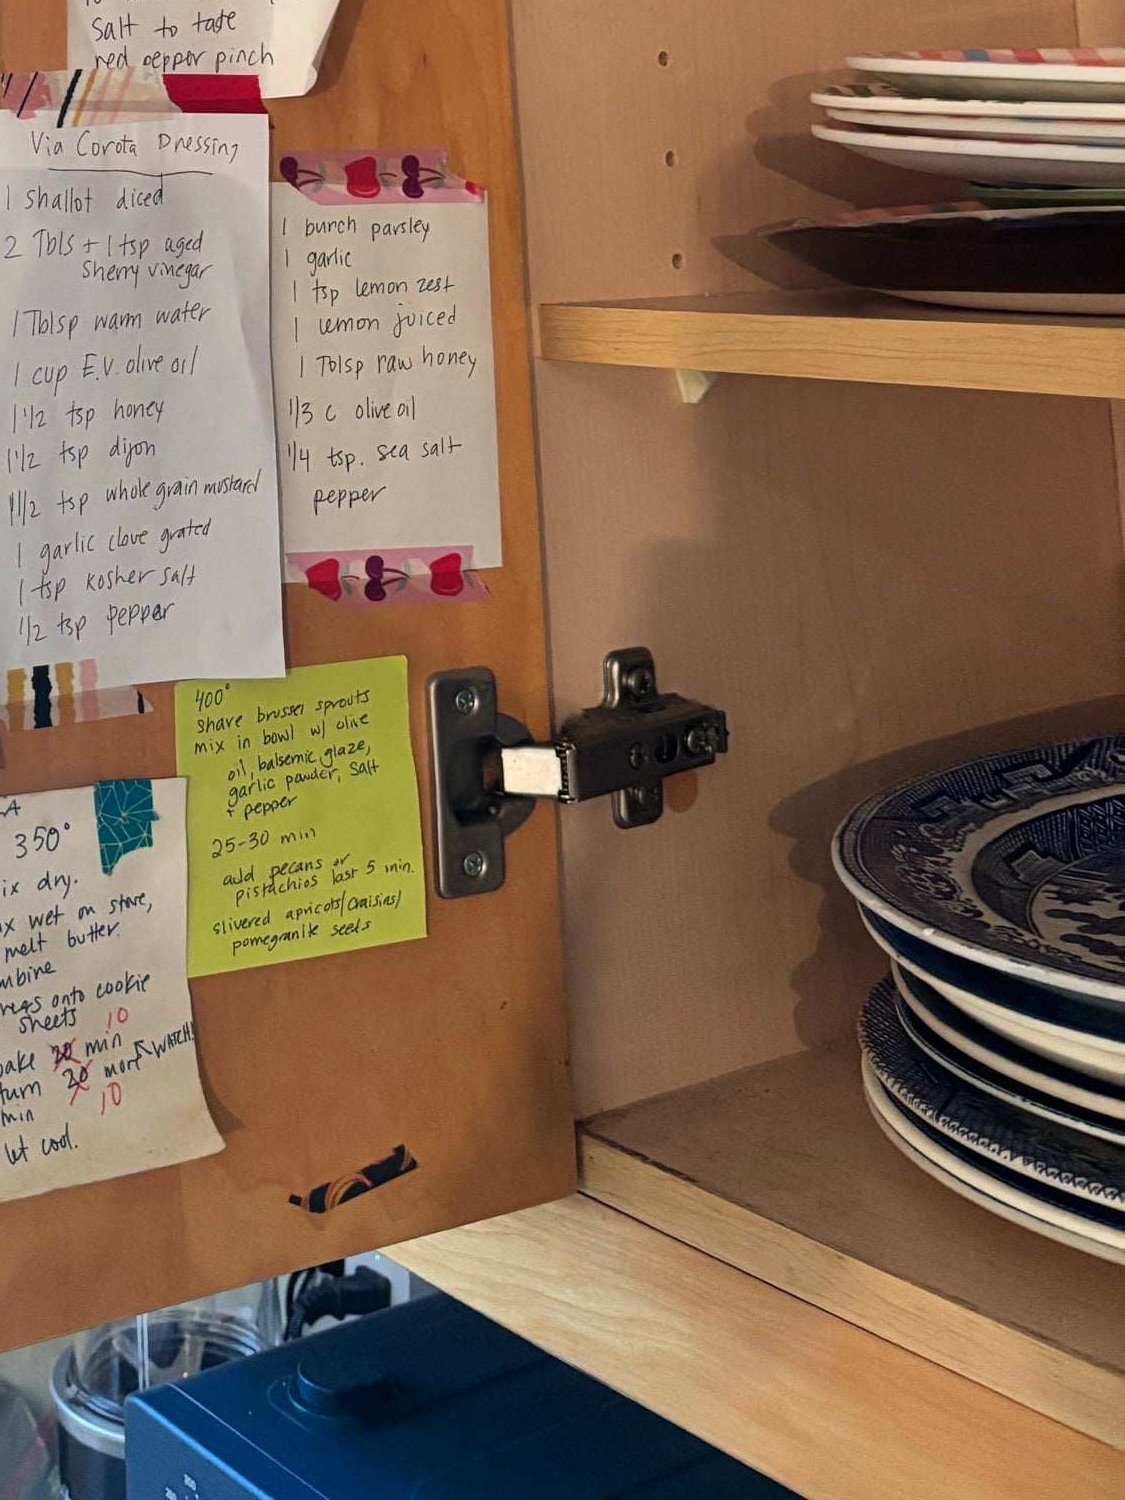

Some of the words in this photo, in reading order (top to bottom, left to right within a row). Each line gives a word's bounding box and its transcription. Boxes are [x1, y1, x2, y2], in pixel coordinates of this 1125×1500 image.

[29, 130, 65, 158] Via
[157, 131, 240, 165] Dressing
[116, 173, 165, 207] diced
[306, 248, 353, 278] garlic
[288, 398, 314, 425] 1/3
[354, 398, 393, 421] olive
[396, 395, 417, 422] oil
[312, 485, 387, 515] pepper
[18, 614, 44, 647] 1/2
[56, 609, 89, 642] tsp
[106, 600, 177, 636] pepper
[194, 737, 225, 755] mix
[237, 735, 251, 750] in
[262, 724, 295, 746] bowl
[336, 713, 370, 731] olive
[211, 829, 270, 859] 25-30
[280, 827, 316, 843] min
[330, 920, 373, 937] seeds
[42, 1131, 80, 1155] cool.
